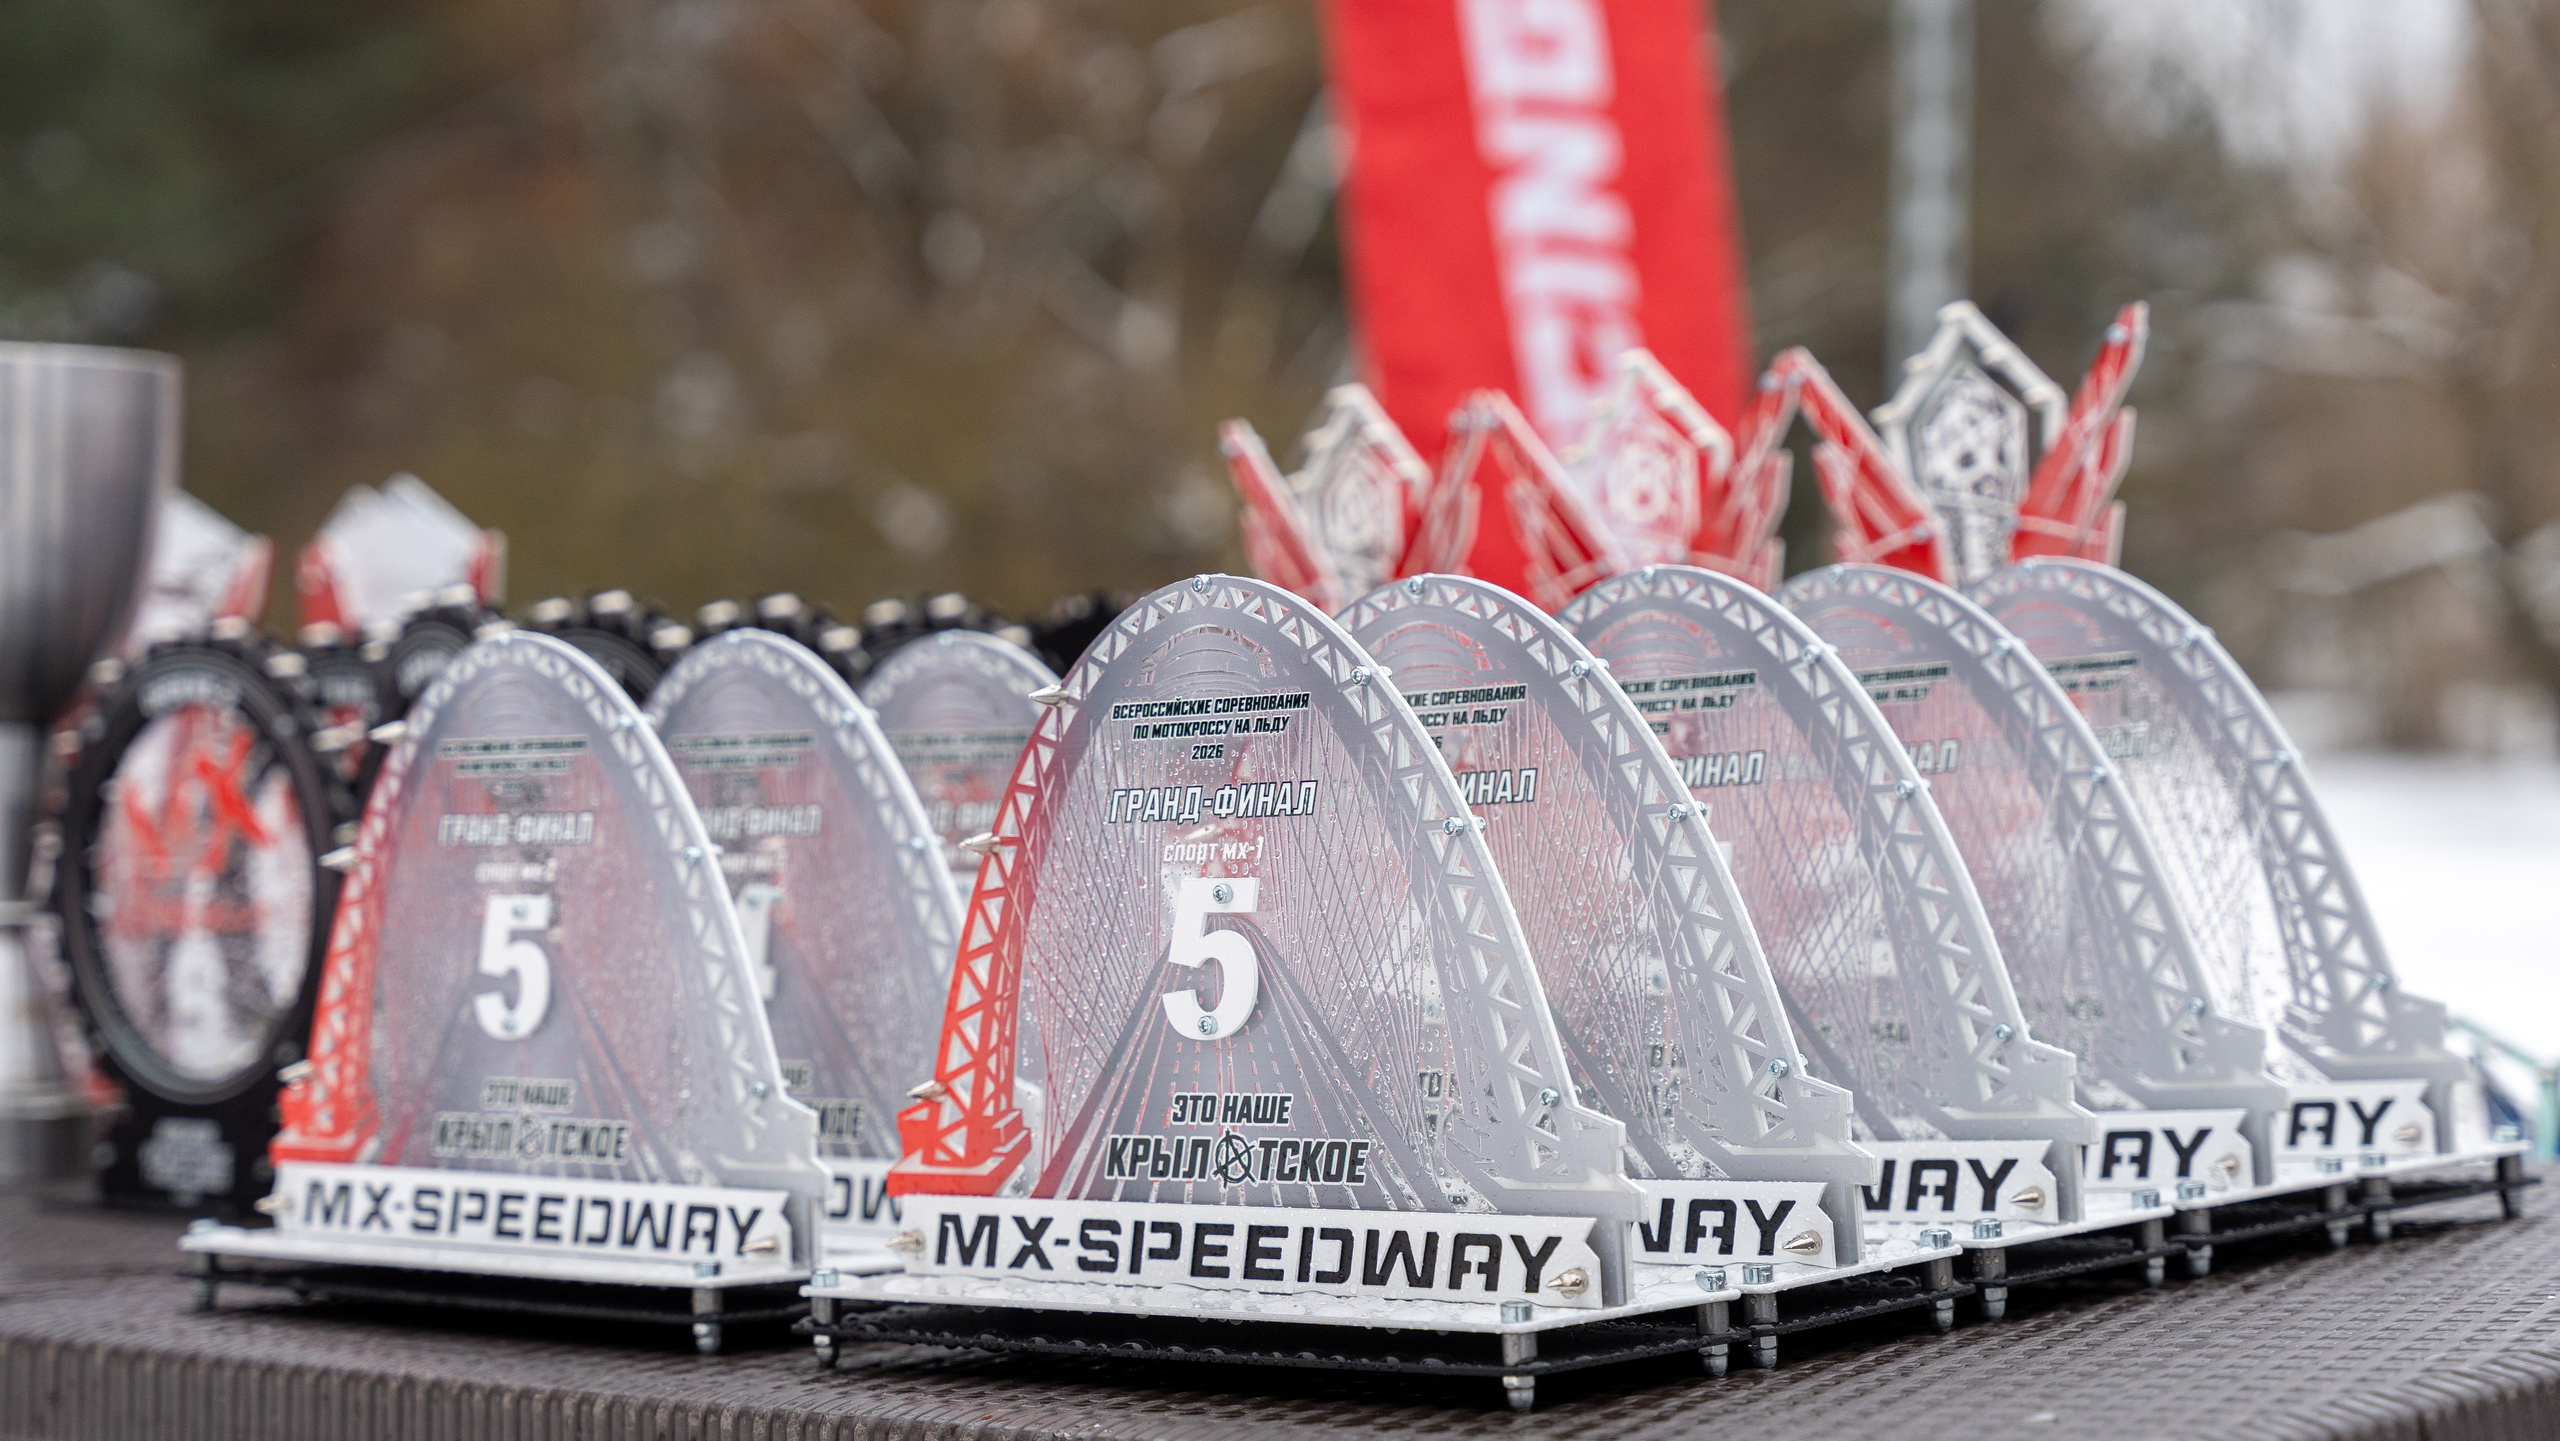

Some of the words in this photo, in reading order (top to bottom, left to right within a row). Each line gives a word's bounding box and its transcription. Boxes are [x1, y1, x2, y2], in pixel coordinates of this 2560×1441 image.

[1112, 697, 1211, 720] ВСЕРОССИЙСКИЕ
[1213, 692, 1311, 715] СОРЕВНОВАНИЯ
[1132, 724, 1150, 740] ПО
[1151, 720, 1231, 739] МОТОКРОССУ
[1233, 717, 1250, 735] НА
[1252, 715, 1291, 735] ЛЬДУ
[1452, 710, 1468, 726] НА
[1191, 744, 1225, 761] 2026
[1108, 779, 1319, 826] ГРАНД-ФИНАЛ
[473, 893, 553, 1041] 5
[1162, 877, 1261, 1042] 5
[1171, 1094, 1218, 1124] ЭТО
[1221, 1094, 1293, 1125] НАШЕ
[2083, 1127, 2213, 1180] AY
[303, 1179, 763, 1256] MX-SPEEDWAY
[935, 1213, 1563, 1294] MX-SPEEDWAY
